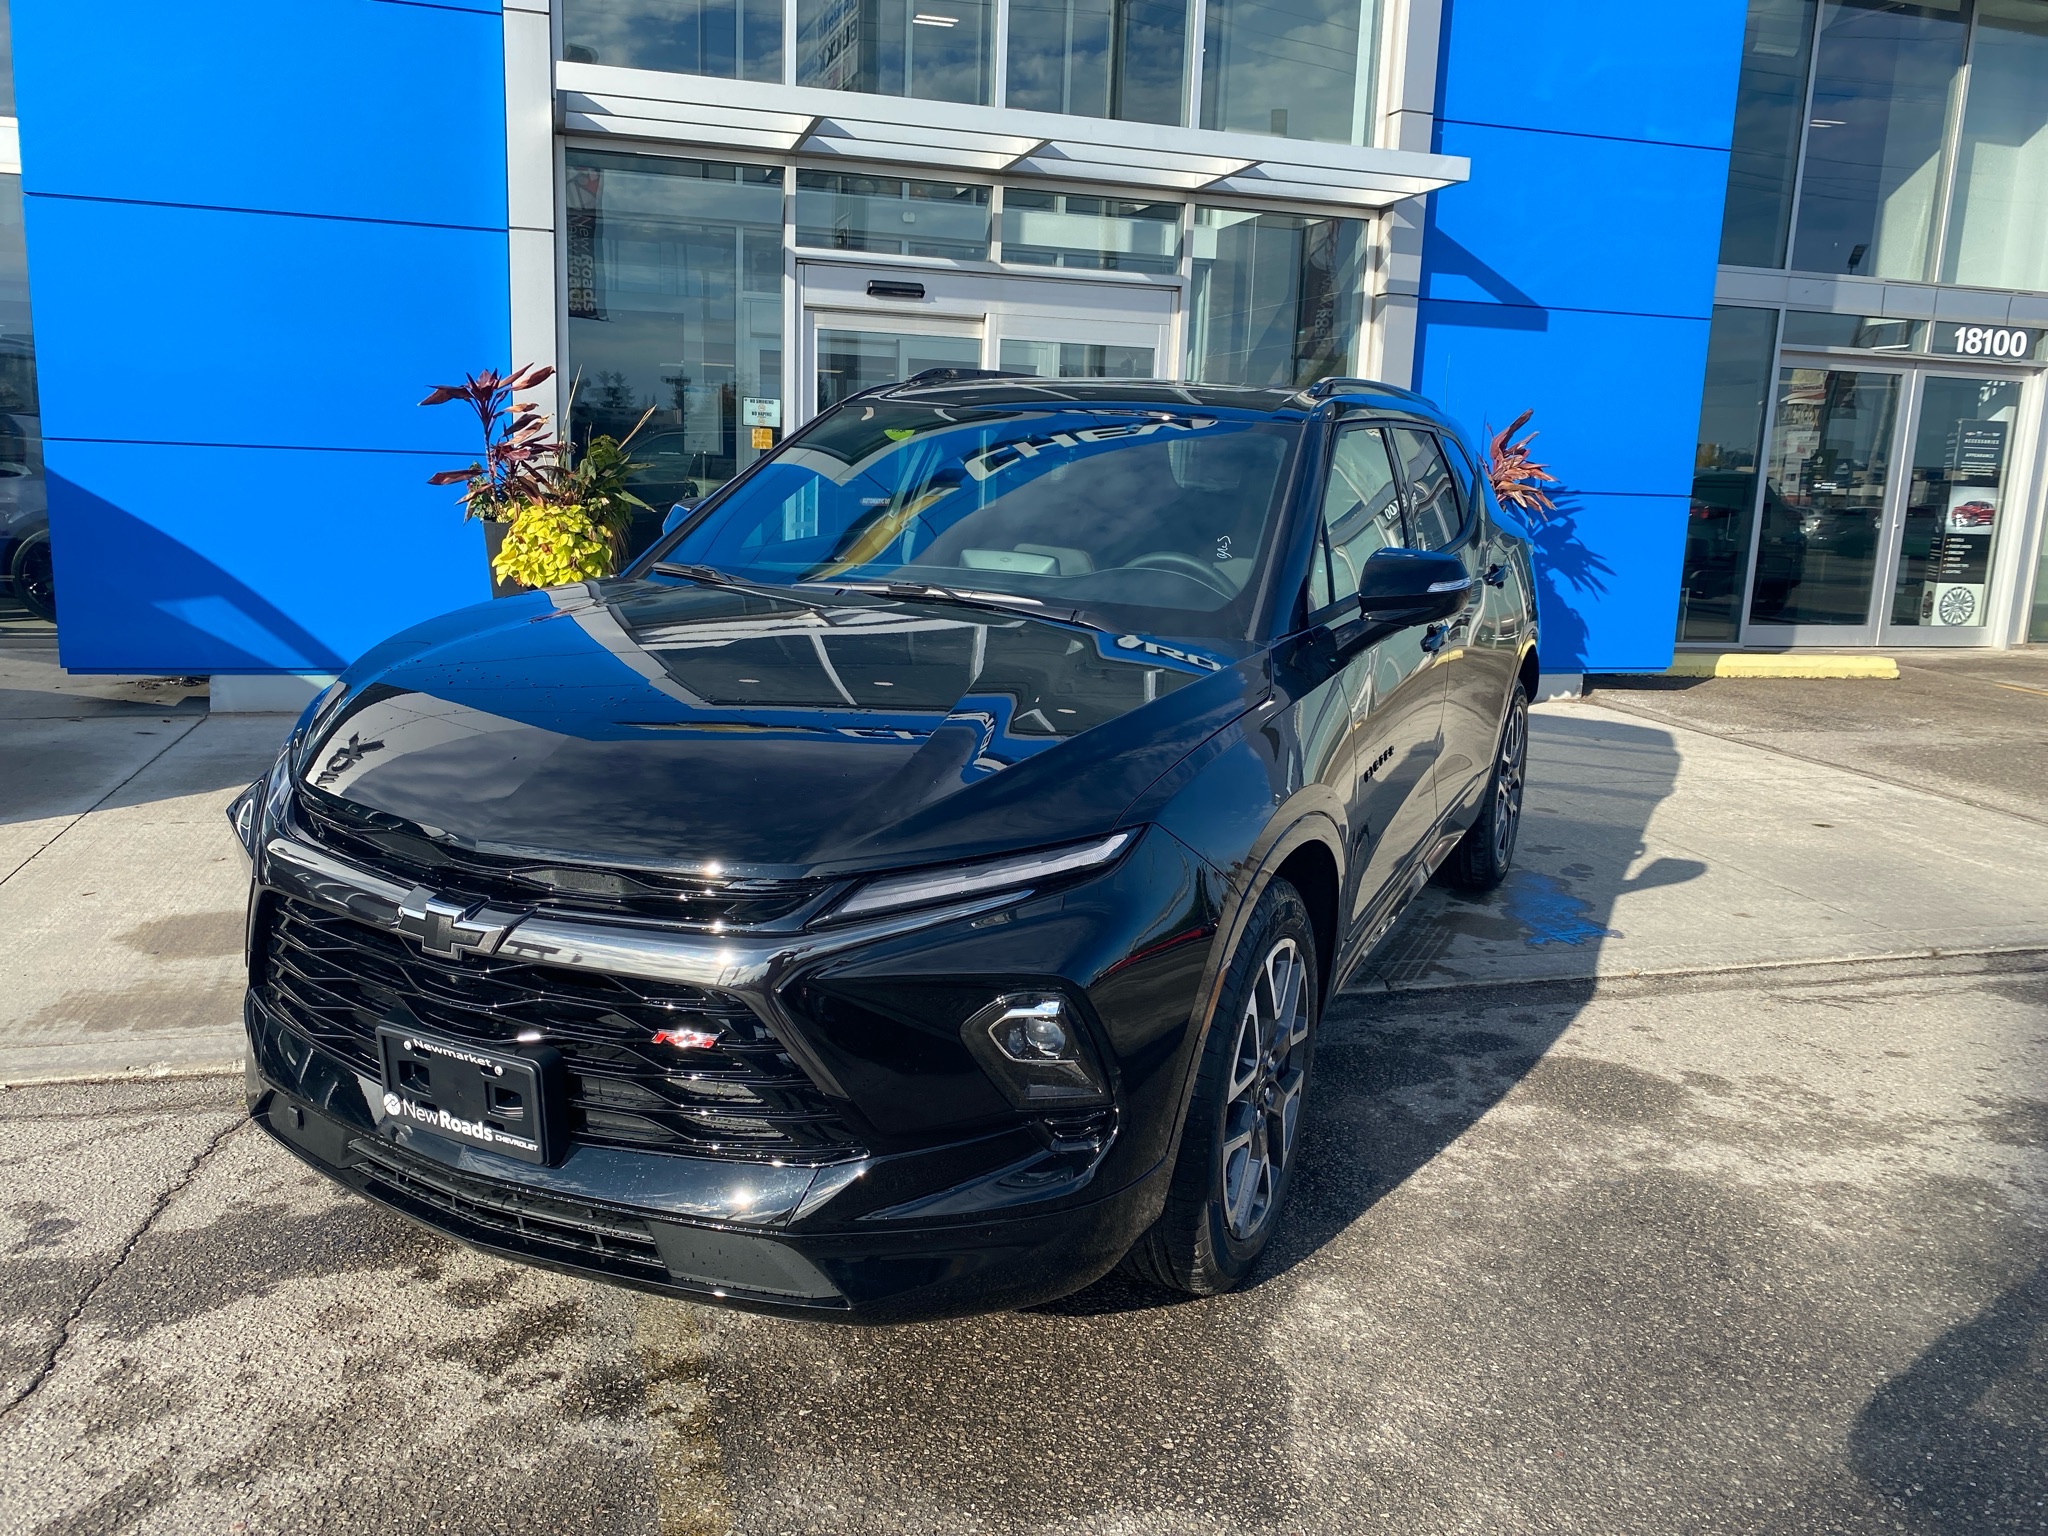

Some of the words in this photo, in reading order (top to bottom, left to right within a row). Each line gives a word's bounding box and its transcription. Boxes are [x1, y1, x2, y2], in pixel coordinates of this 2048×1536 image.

[1954, 326, 2028, 357] 18100
[412, 1038, 493, 1068] Newmarket
[402, 1098, 494, 1142] NewRoads
[495, 1133, 539, 1152] CHEVROLET
